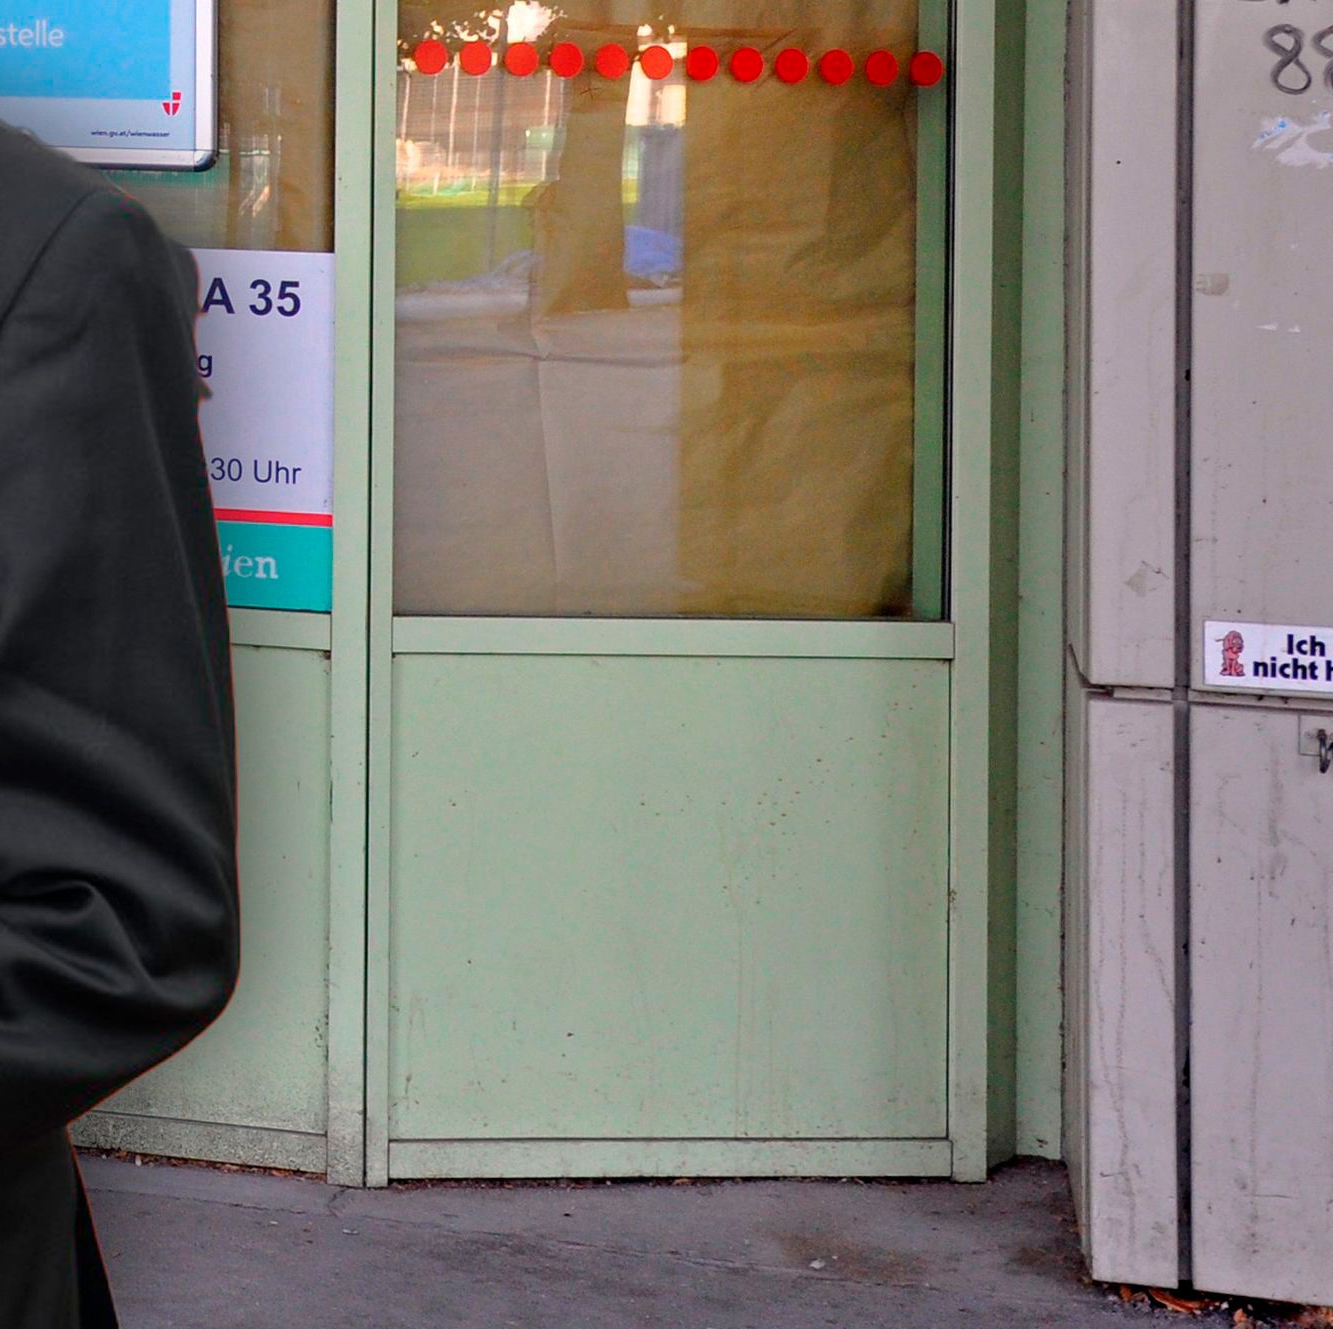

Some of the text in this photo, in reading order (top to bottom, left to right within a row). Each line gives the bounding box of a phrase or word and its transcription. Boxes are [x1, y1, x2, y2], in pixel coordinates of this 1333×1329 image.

[201, 278, 302, 317] A 35
[253, 460, 302, 485] Uhr
[222, 544, 279, 580] ien
[1287, 634, 1325, 656] Ich
[1253, 657, 1319, 681] nicht
